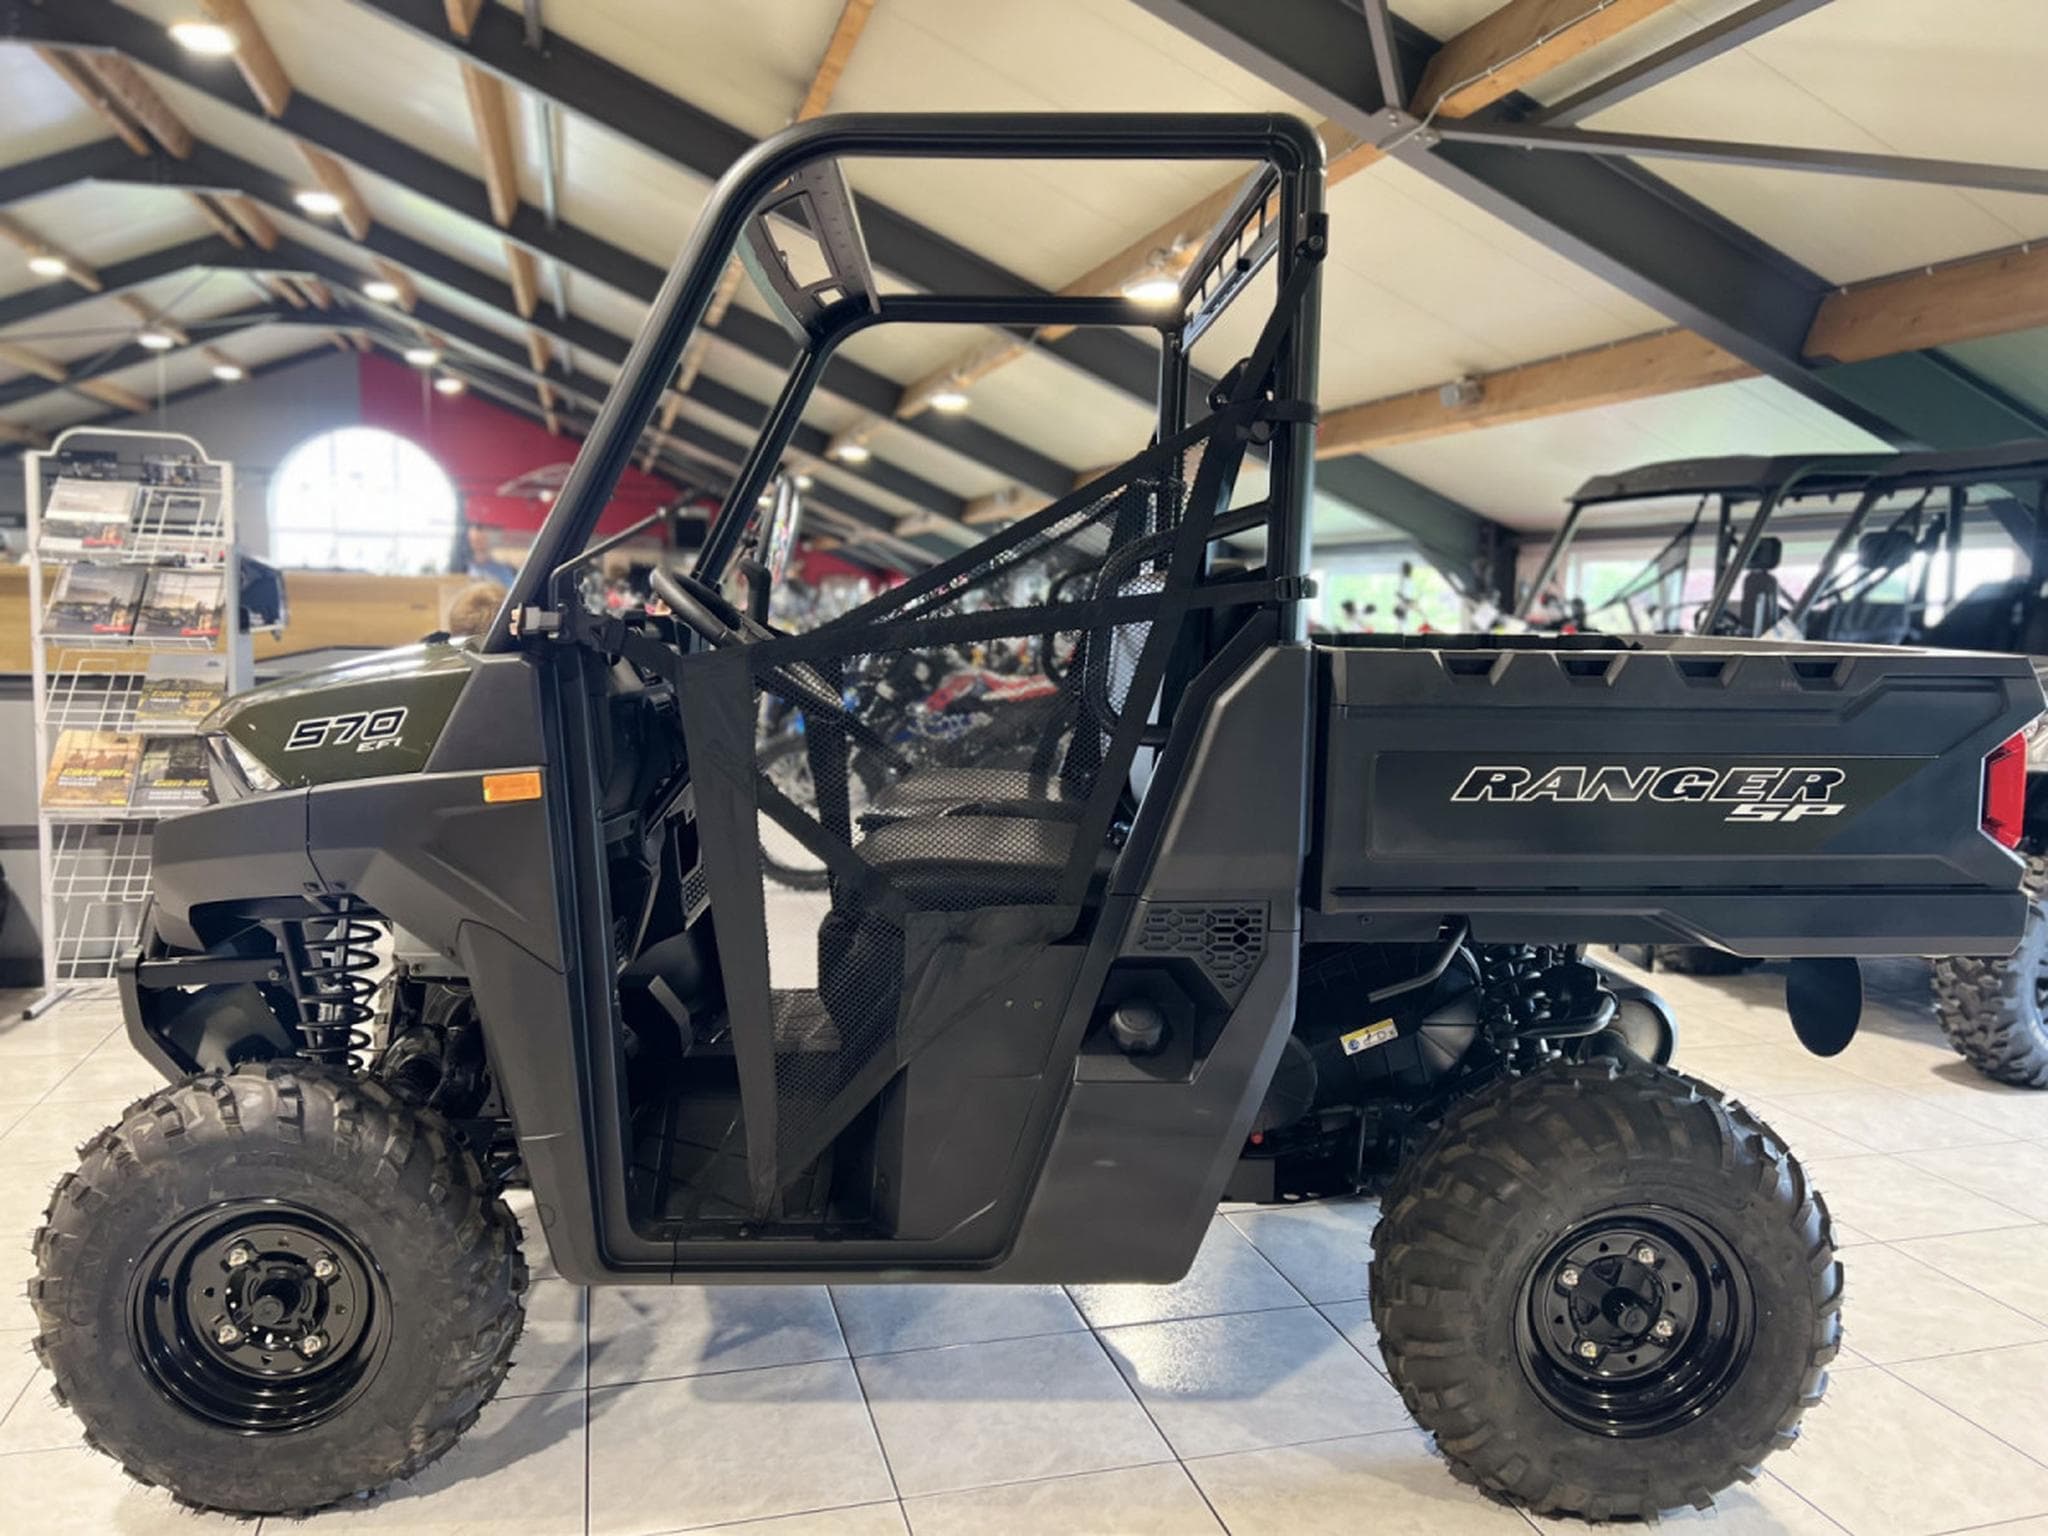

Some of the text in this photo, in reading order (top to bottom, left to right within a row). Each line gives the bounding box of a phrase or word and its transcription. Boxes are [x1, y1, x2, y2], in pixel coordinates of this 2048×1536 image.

[284, 706, 408, 752] 570
[356, 737, 403, 753] EFI
[1450, 765, 1846, 802] RANGER
[1724, 803, 1846, 822] SP
